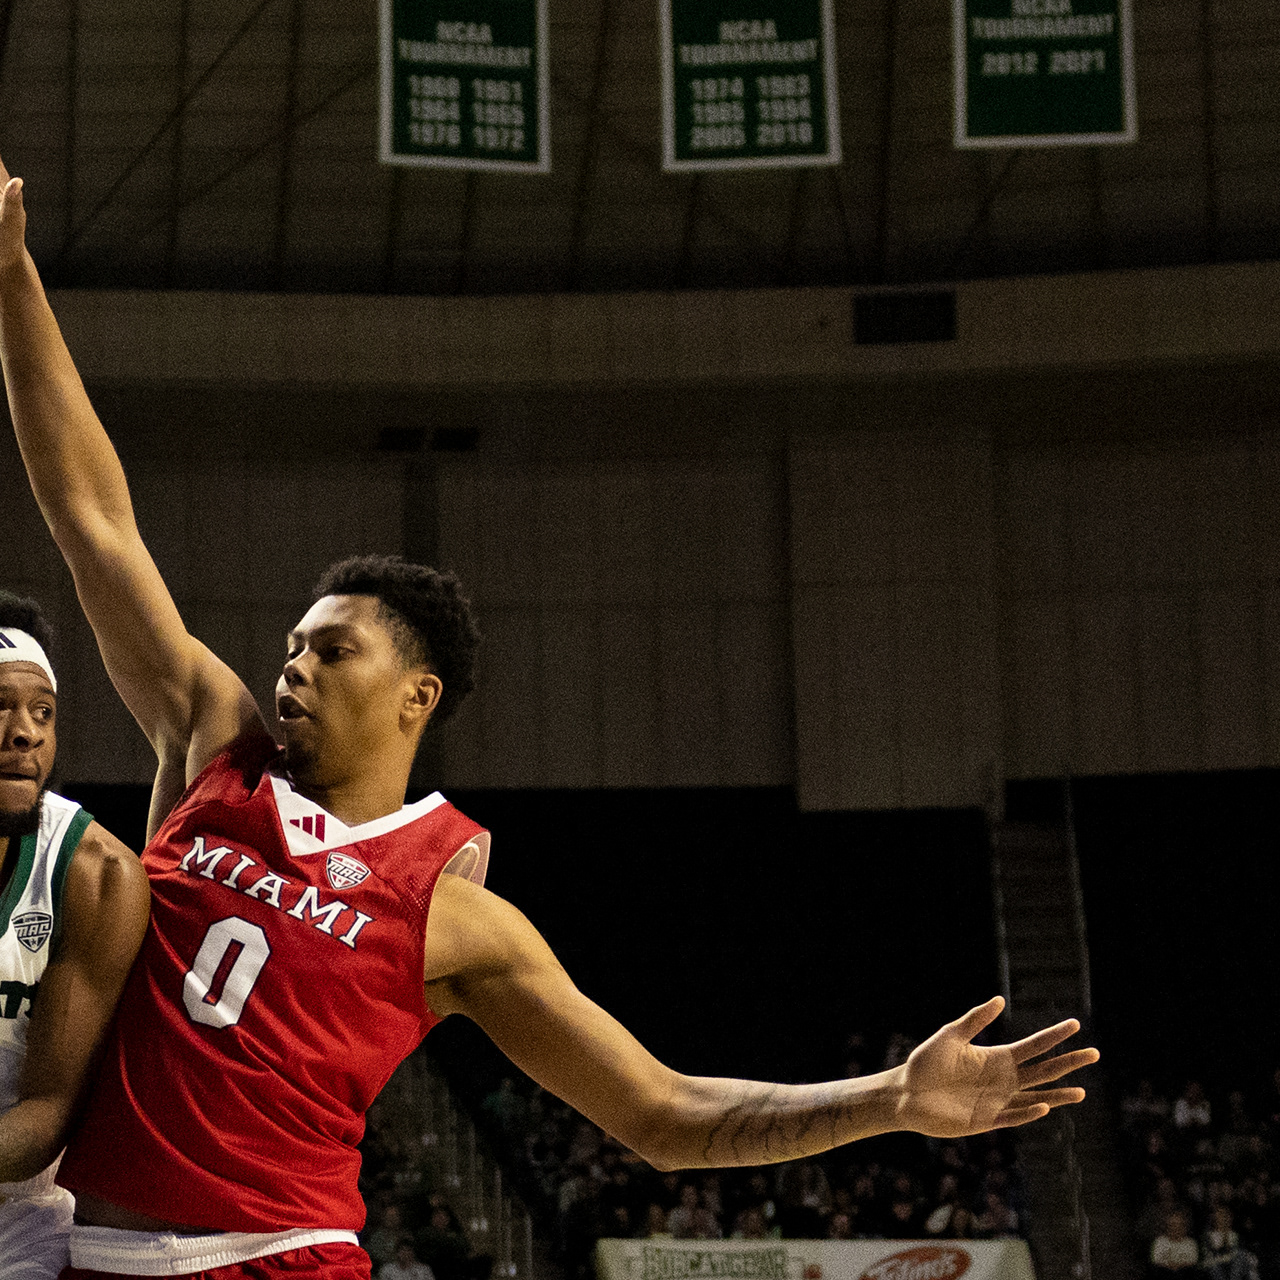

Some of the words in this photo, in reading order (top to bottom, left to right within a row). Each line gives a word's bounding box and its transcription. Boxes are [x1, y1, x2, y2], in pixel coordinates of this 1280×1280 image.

[436, 21, 493, 44] NCAA
[719, 19, 778, 42] NCAA
[972, 14, 1115, 39] TOURNAMENT
[398, 38, 532, 67] TOURNAMENT
[680, 39, 818, 66] TOURNAMENT
[179, 837, 375, 951] MIAMI
[15, 922, 50, 938] MAC
[182, 915, 271, 1029] 0
